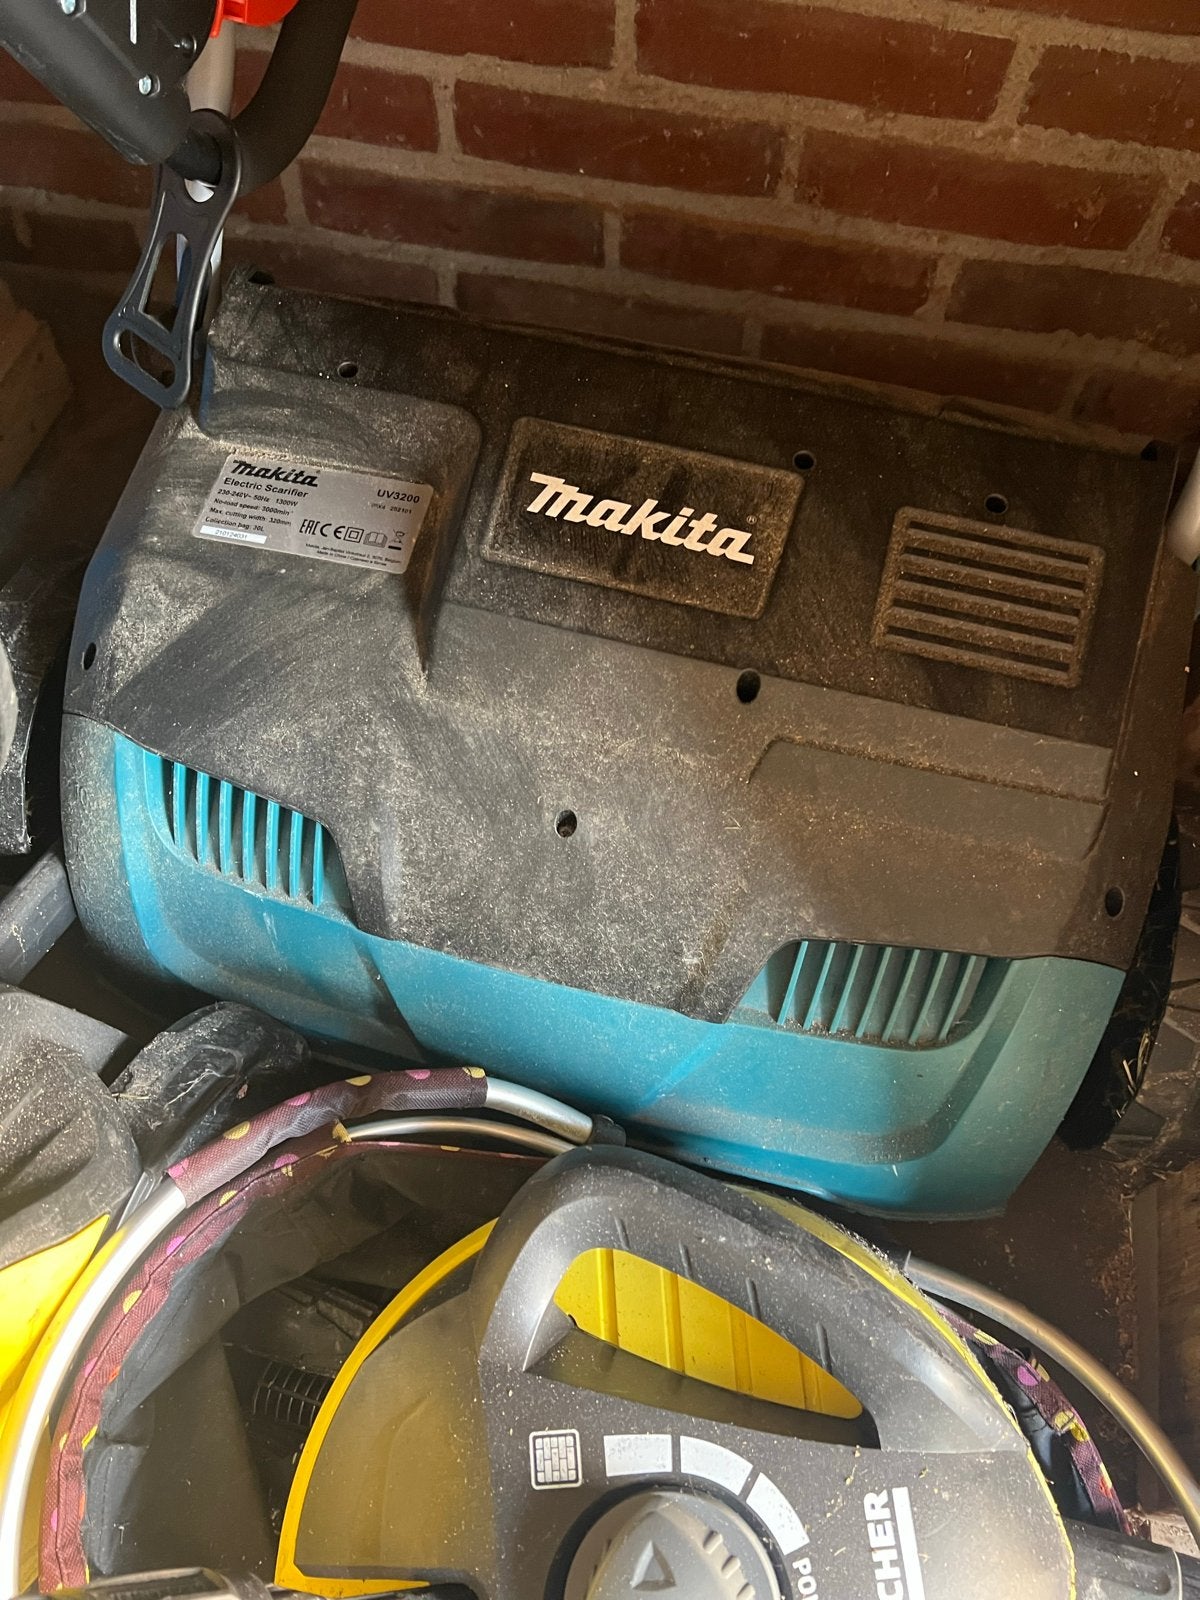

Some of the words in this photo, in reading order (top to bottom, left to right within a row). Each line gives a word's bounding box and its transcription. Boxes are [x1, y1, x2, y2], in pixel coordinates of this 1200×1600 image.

[224, 477, 262, 491] Electric
[265, 484, 309, 498] Scarifier
[377, 489, 420, 503] UV3200
[275, 499, 299, 507] 1300W
[526, 472, 755, 564] makita
